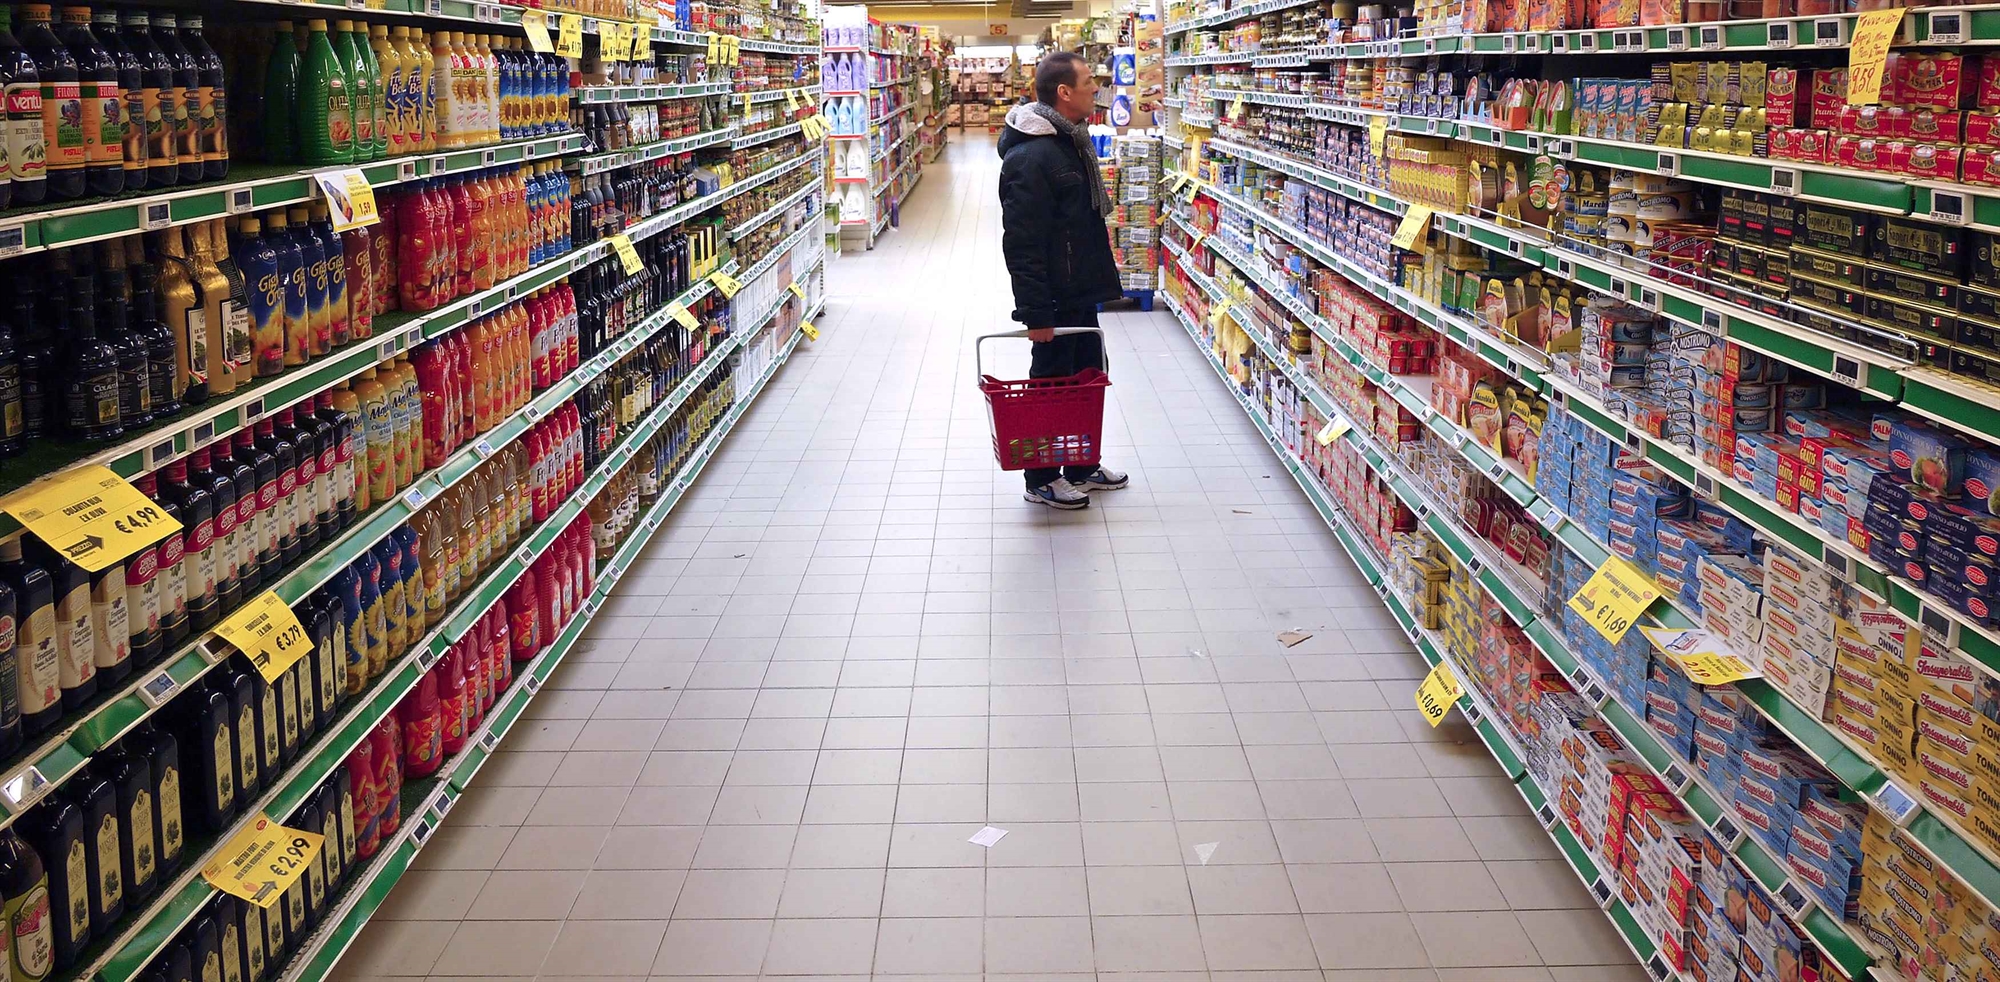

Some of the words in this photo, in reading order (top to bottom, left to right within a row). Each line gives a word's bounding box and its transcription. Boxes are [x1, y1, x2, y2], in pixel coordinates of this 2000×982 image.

[359, 202, 371, 215] 1,59
[1680, 333, 1711, 349] NOSTROMO
[1738, 442, 1756, 458] PALMERA
[1800, 448, 1817, 466] GRATIS
[1734, 466, 1753, 482] PALMERA
[1778, 464, 1793, 482] GRATIS
[1824, 461, 1847, 477] PALMERA
[1800, 474, 1816, 493] GRATIS
[1776, 489, 1793, 507] GRATIS
[1800, 500, 1821, 519] PALMERA
[1824, 490, 1847, 505] PALMERA
[115, 520, 133, 534] €
[127, 506, 160, 528] 4,99
[1848, 527, 1866, 548] GRATIS
[1772, 560, 1800, 582] MARUZZELLA
[1770, 586, 1798, 608] MARUZZELLA
[1596, 604, 1609, 620] €
[1603, 610, 1628, 635] 1,69
[1770, 612, 1797, 635] MARUZZELLA
[276, 636, 286, 651] €
[282, 624, 301, 646] 3,79
[1878, 637, 1903, 659] TONNO
[1837, 636, 1878, 663] Insuperabile
[1884, 659, 1910, 682] TONNO
[1916, 660, 1975, 682] Insuperabile
[1836, 664, 1875, 691] Insuperabile
[1880, 688, 1904, 712] TONNO
[1920, 693, 1973, 726] Insuperabile
[1880, 716, 1903, 740] TONNO
[1920, 721, 1969, 756] Insuperabile
[1742, 751, 1780, 779] Insuperabile
[1882, 742, 1907, 767] TONNO
[1920, 754, 1969, 789] Insuperabile
[1740, 777, 1774, 805] Insuperabile
[1920, 781, 1967, 818] Insuperabile
[1735, 801, 1769, 831] Insuperabile
[1806, 800, 1844, 831] Insuperabile
[278, 838, 311, 869] 2,99
[1792, 828, 1830, 860] Insuperabile
[1899, 838, 1931, 871] NOSTROMO
[270, 864, 289, 876] €
[1788, 855, 1825, 888] Insuperabile
[1895, 866, 1928, 899] NOSTROMO
[1892, 890, 1922, 924] NOSTROMO
[1888, 919, 1919, 953] NOSTROMO
